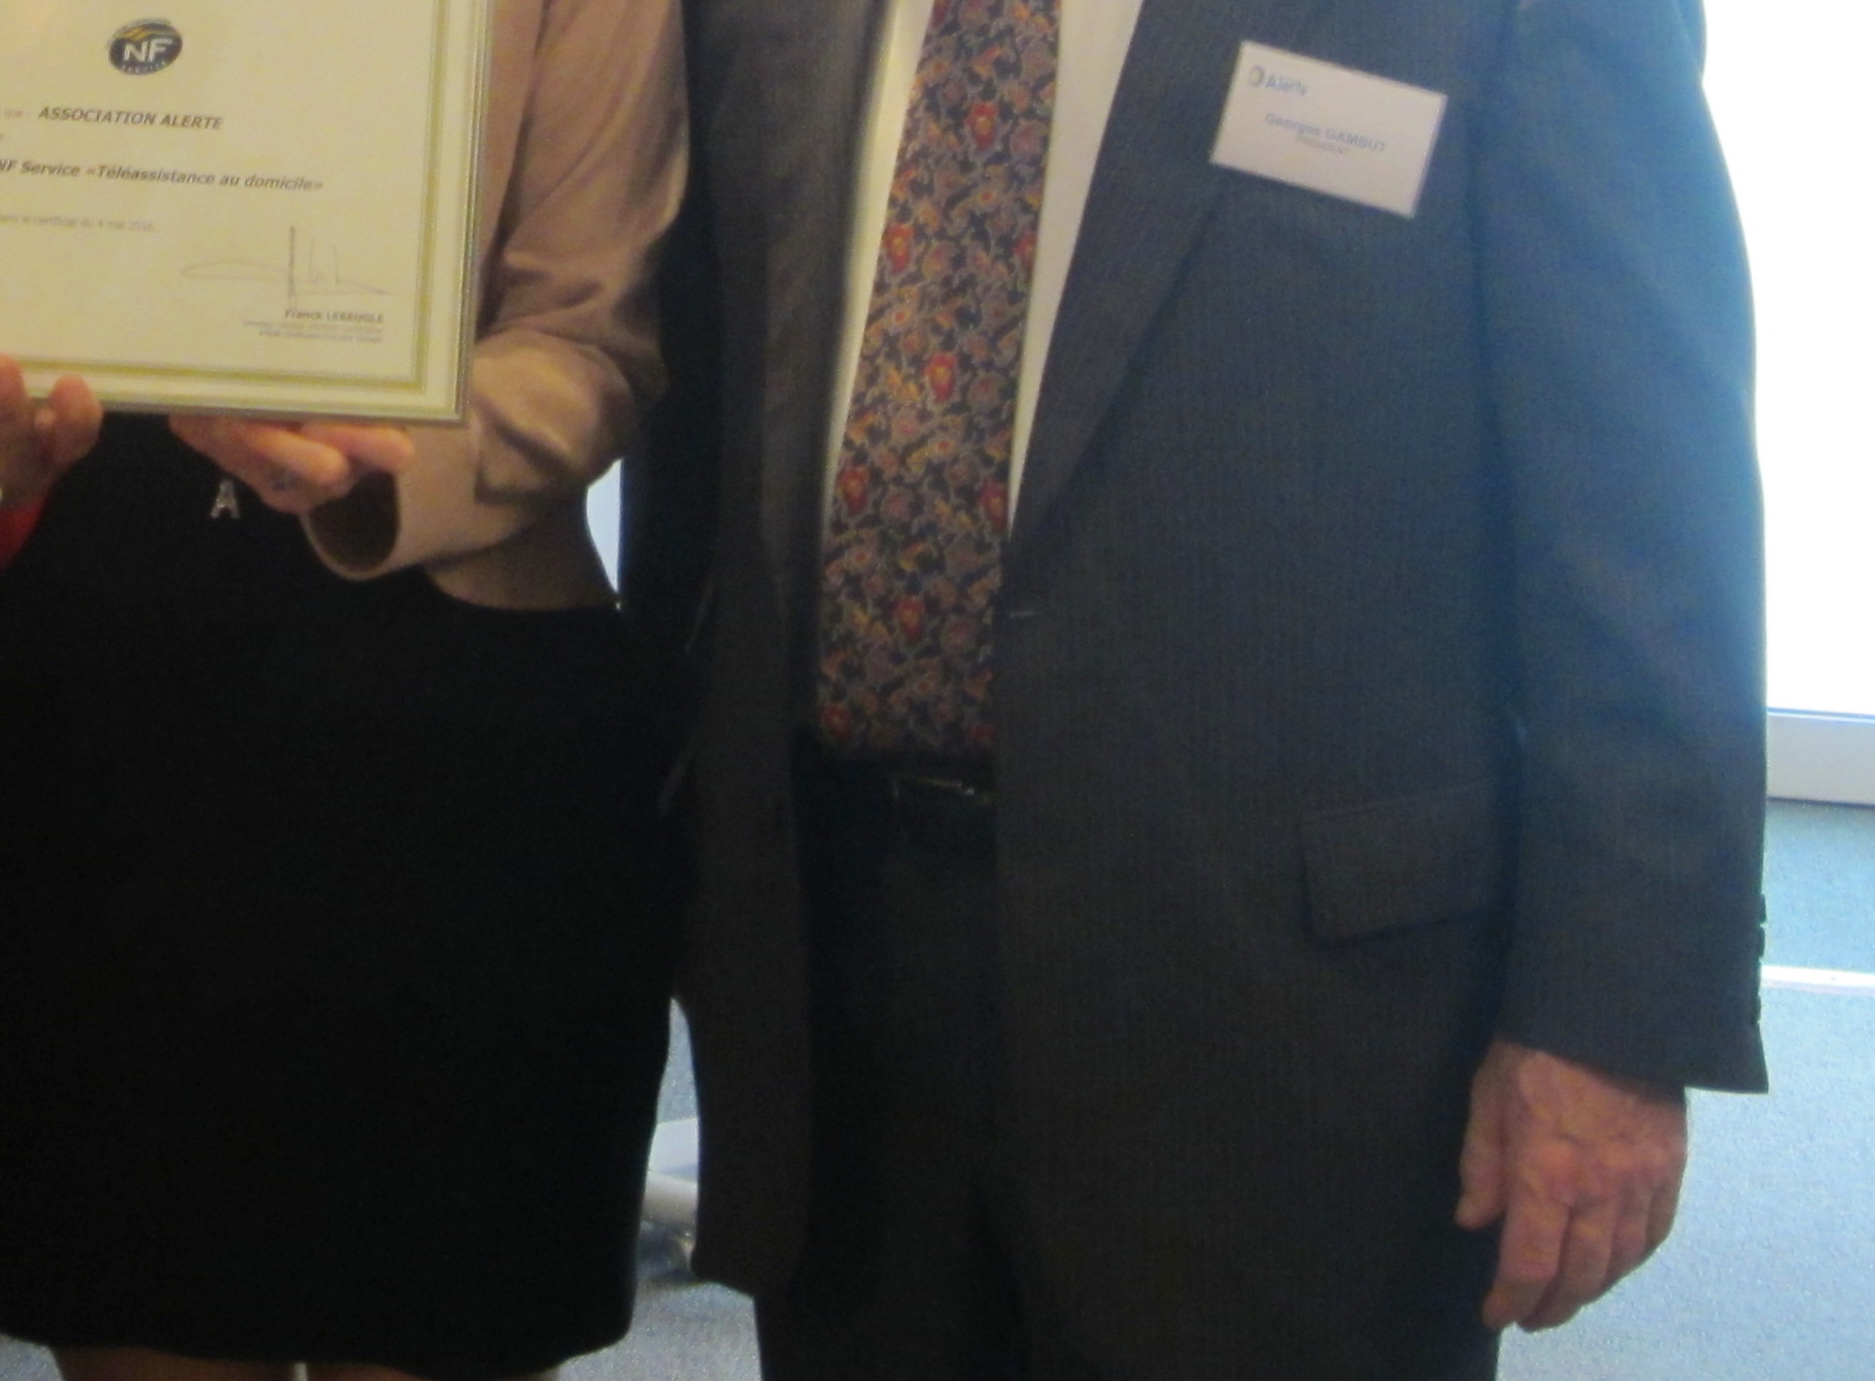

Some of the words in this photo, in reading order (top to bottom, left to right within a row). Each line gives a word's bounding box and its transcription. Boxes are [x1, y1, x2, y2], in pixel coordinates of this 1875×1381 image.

[124, 38, 174, 63] NF
[37, 106, 157, 127] ASSOCIATION
[159, 113, 224, 130] ALERTE
[19, 161, 81, 177] Service
[218, 174, 241, 187] au
